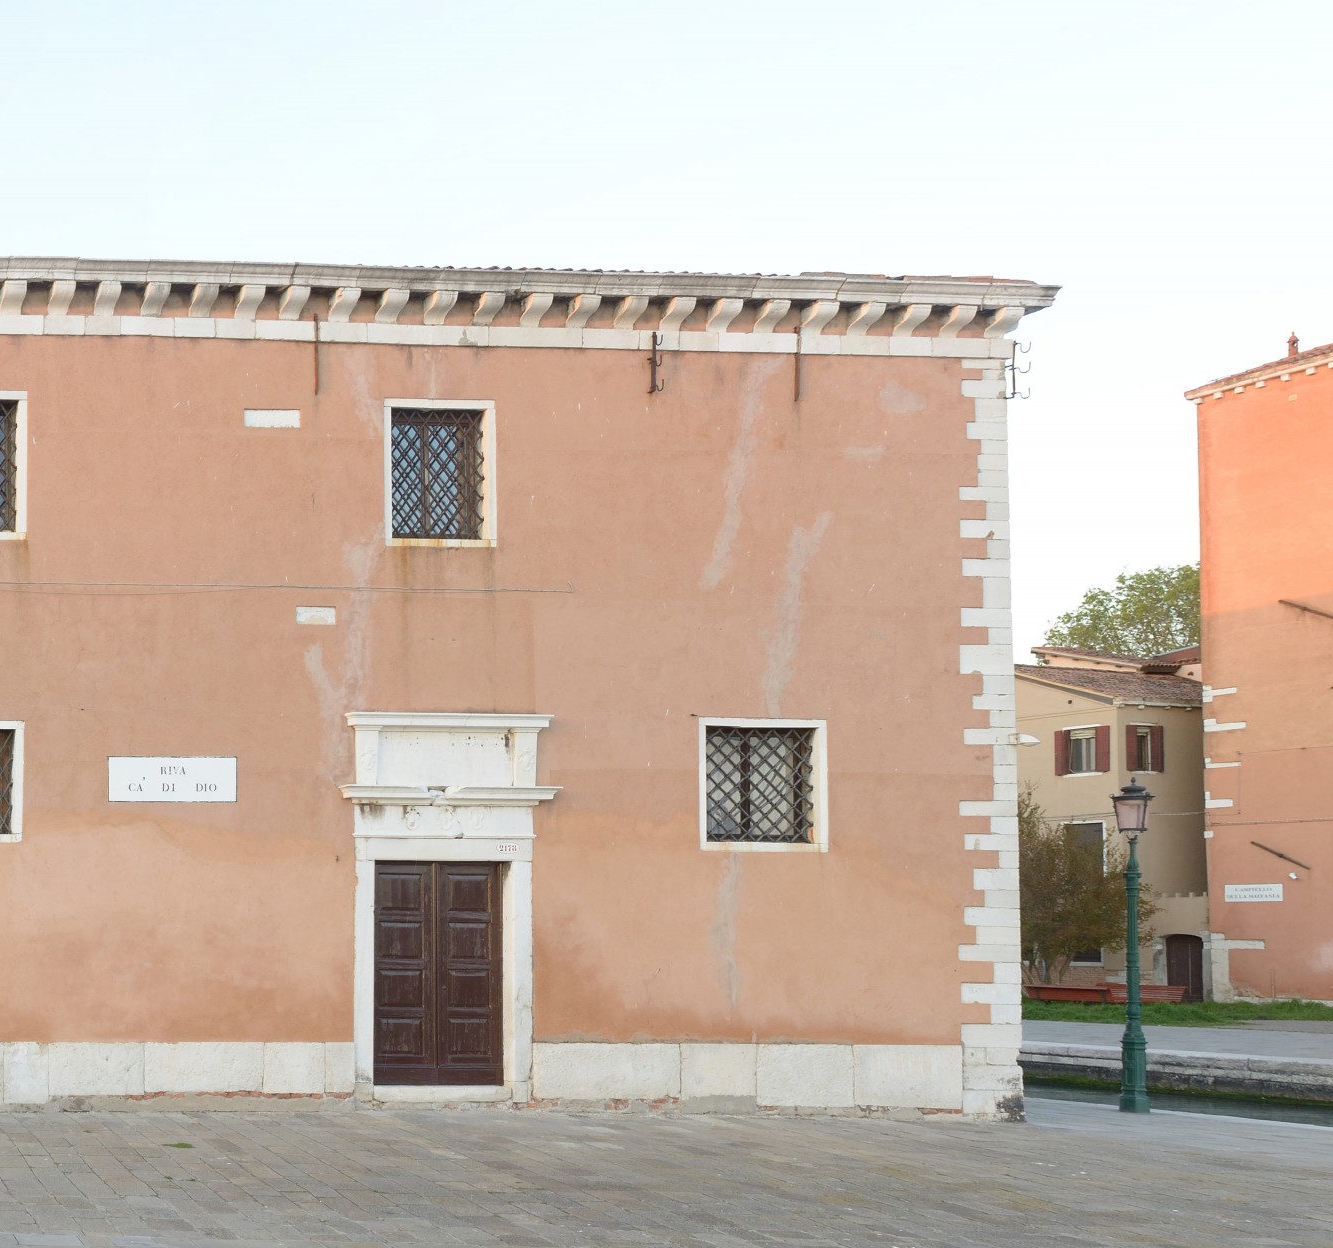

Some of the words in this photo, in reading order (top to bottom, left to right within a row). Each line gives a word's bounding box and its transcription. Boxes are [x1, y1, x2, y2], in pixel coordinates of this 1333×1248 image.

[160, 766, 186, 775] RIVA
[162, 783, 175, 792] DI
[195, 783, 217, 792] DIO
